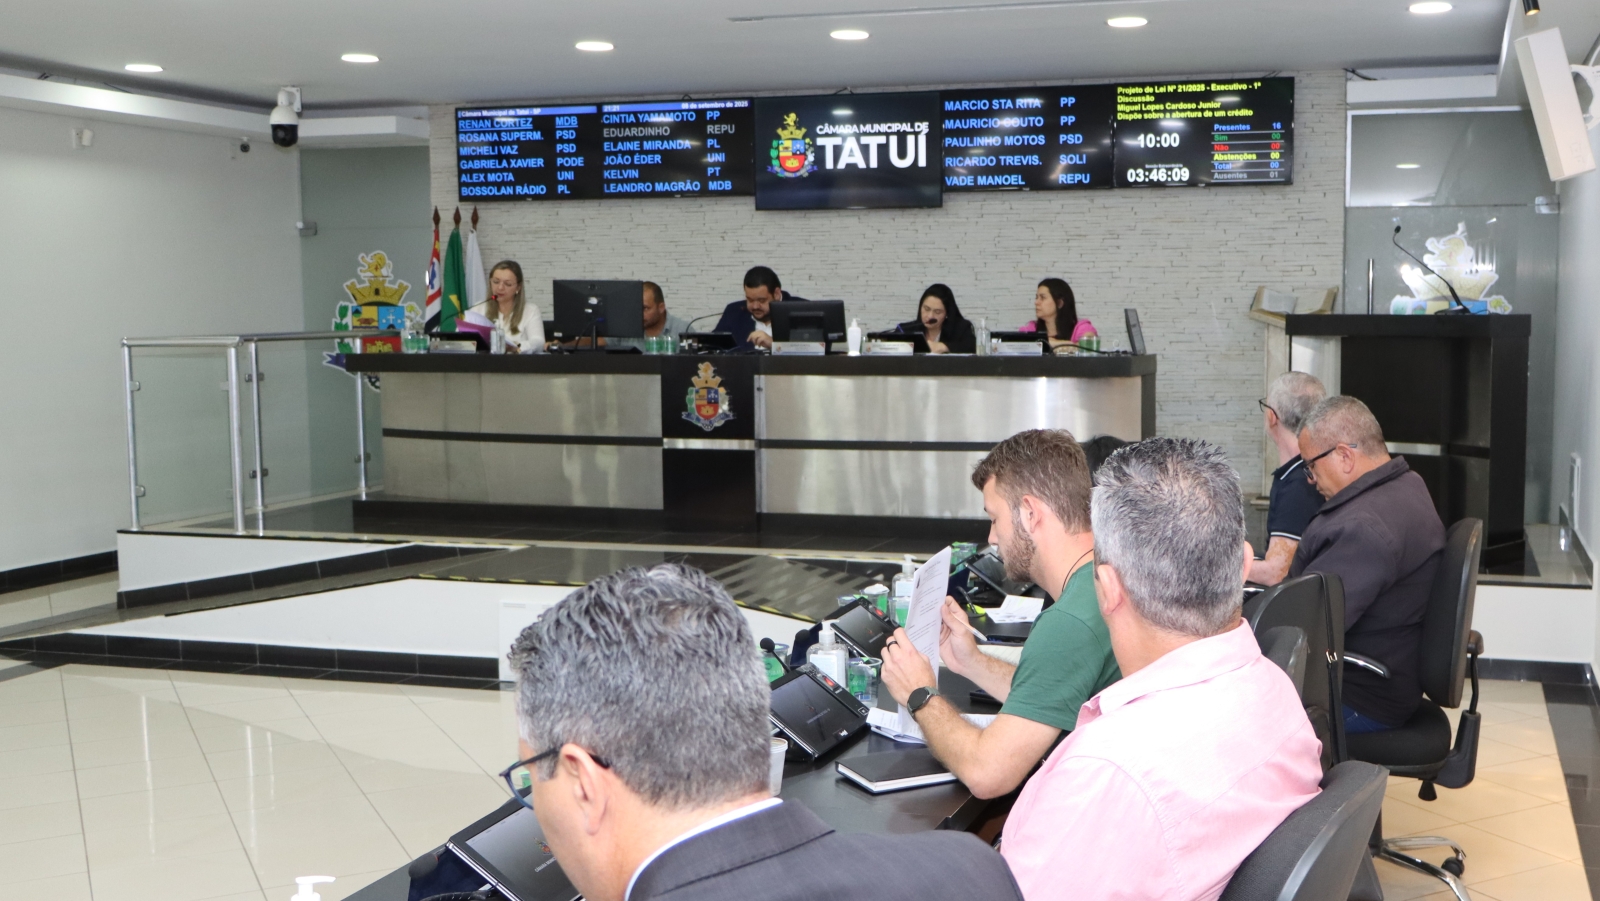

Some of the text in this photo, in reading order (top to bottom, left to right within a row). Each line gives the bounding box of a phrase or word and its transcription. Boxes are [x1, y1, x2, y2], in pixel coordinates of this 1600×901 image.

[1117, 86, 1143, 95] Projeto
[1178, 84, 1205, 92] 21/2025
[1211, 83, 1247, 91] Executivo
[945, 97, 1075, 110] MARCIO STA RITA PP
[1117, 104, 1140, 112] Miguel
[1142, 103, 1164, 111] Lopes
[1165, 101, 1196, 110] Cardoso
[459, 116, 578, 129] RENAN CORTEZ MDB
[603, 111, 720, 123] CINTIA YAMAMOTO PP
[945, 116, 1075, 129] MAURICIO COUTO PP
[1117, 112, 1142, 121] Dispõe
[604, 124, 735, 137] EDUARDINHO REPU
[816, 122, 929, 134] CÂMARA MUNICIPAL DE
[459, 130, 576, 142] ROSANA SUPERM. PSD
[945, 134, 1083, 147] PAULINHO MOTOS PSD
[1138, 133, 1180, 148] 10:00
[460, 144, 576, 156] MICHELI VAZ PSD
[604, 139, 720, 151] ELAINE MIRANDA PL
[816, 131, 927, 169] TATUÍ
[460, 157, 584, 169] GABRIELA XAVIER PODE
[604, 153, 725, 165] JOÃO ÉDER UNI
[945, 154, 1086, 166] RICARDO TREVIS. SOLI
[1214, 153, 1257, 161] Abstenções
[461, 171, 574, 182] ALEX MOTA UNI
[604, 167, 720, 179] KELVIN PT
[1127, 167, 1190, 182] 03:46:09
[945, 174, 1090, 186] VADE MANOEL REPU
[461, 184, 570, 196] BOSSOLAN RÁDIO PL
[604, 180, 732, 193] LEANDRO MAGRÃO MDB
